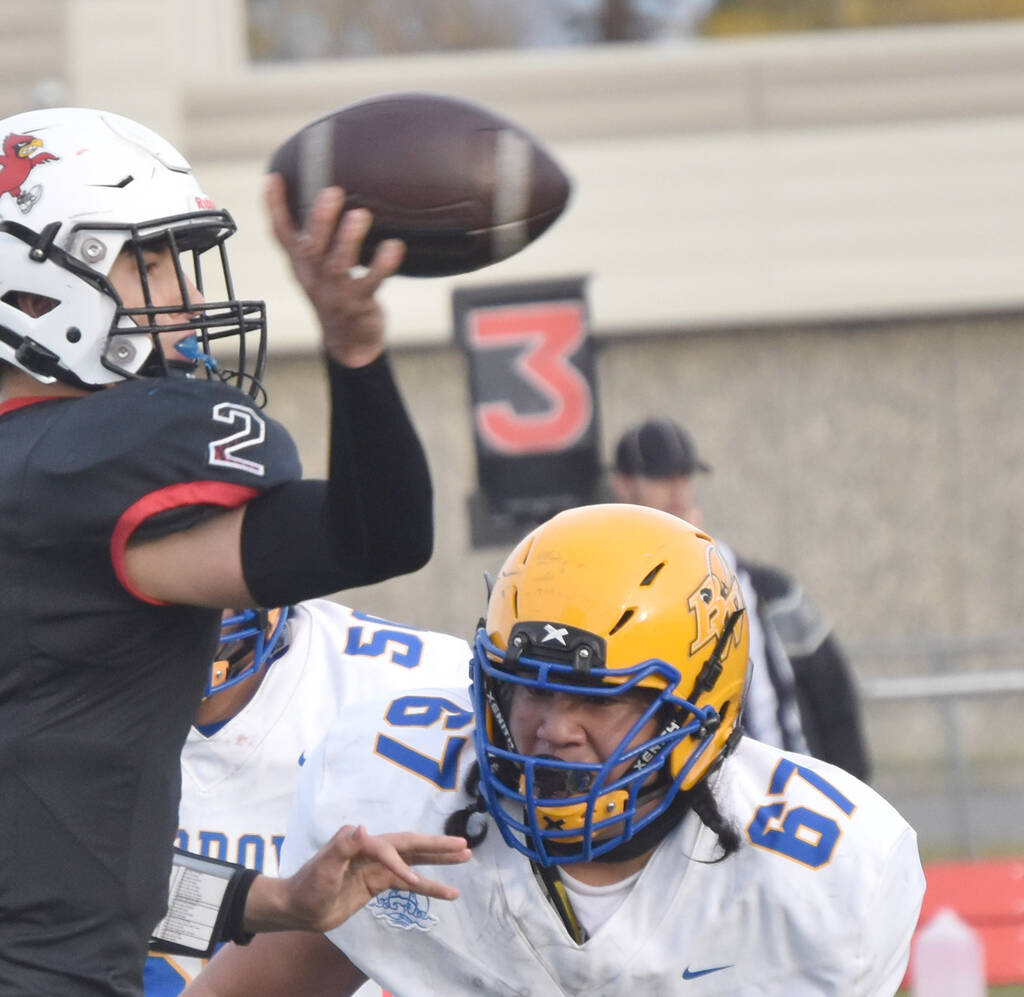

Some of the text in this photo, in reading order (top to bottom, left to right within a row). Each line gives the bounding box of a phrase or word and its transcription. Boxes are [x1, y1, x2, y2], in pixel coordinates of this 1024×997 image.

[469, 303, 592, 455] 3
[208, 402, 265, 476] 2
[342, 608, 425, 670] 5
[374, 695, 476, 792] 67
[633, 719, 681, 771] XENH
[744, 757, 858, 872] 67
